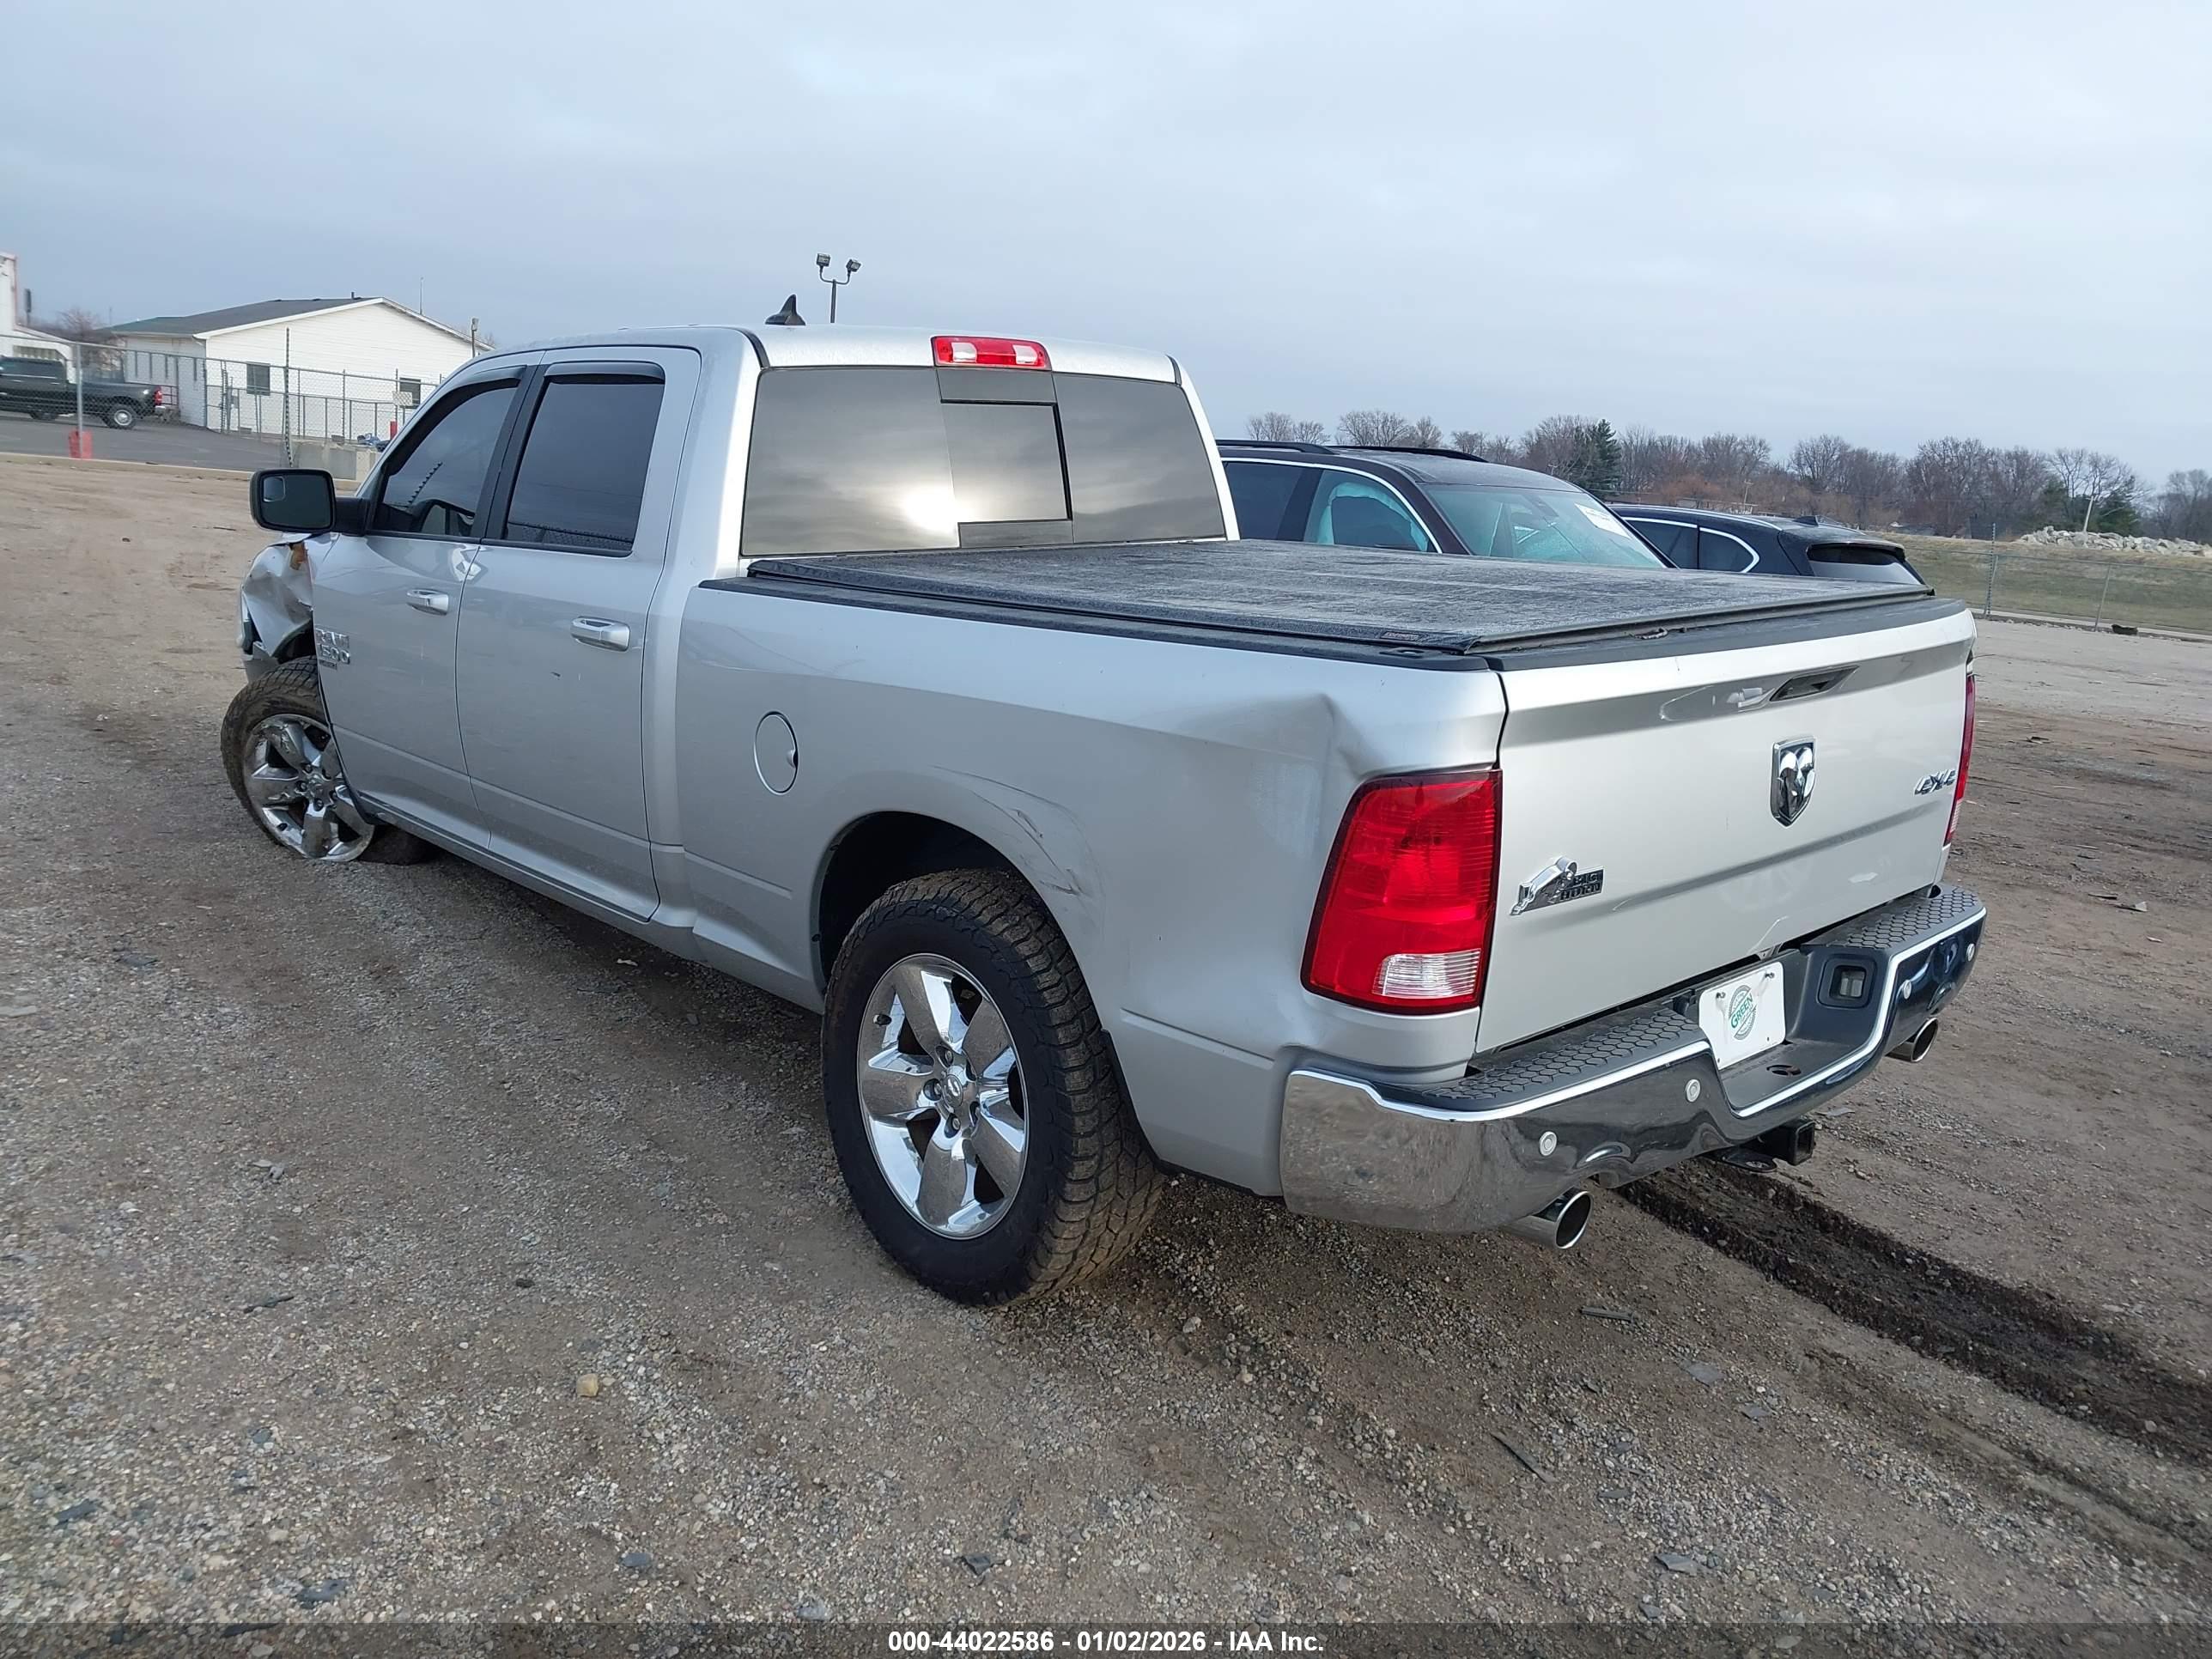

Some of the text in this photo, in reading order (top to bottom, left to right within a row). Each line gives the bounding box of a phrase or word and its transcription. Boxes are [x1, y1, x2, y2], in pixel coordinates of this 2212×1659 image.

[1573, 873, 1599, 885] BIG
[1559, 882, 1601, 900] HORN
[1730, 993, 1753, 1029] GREEN
